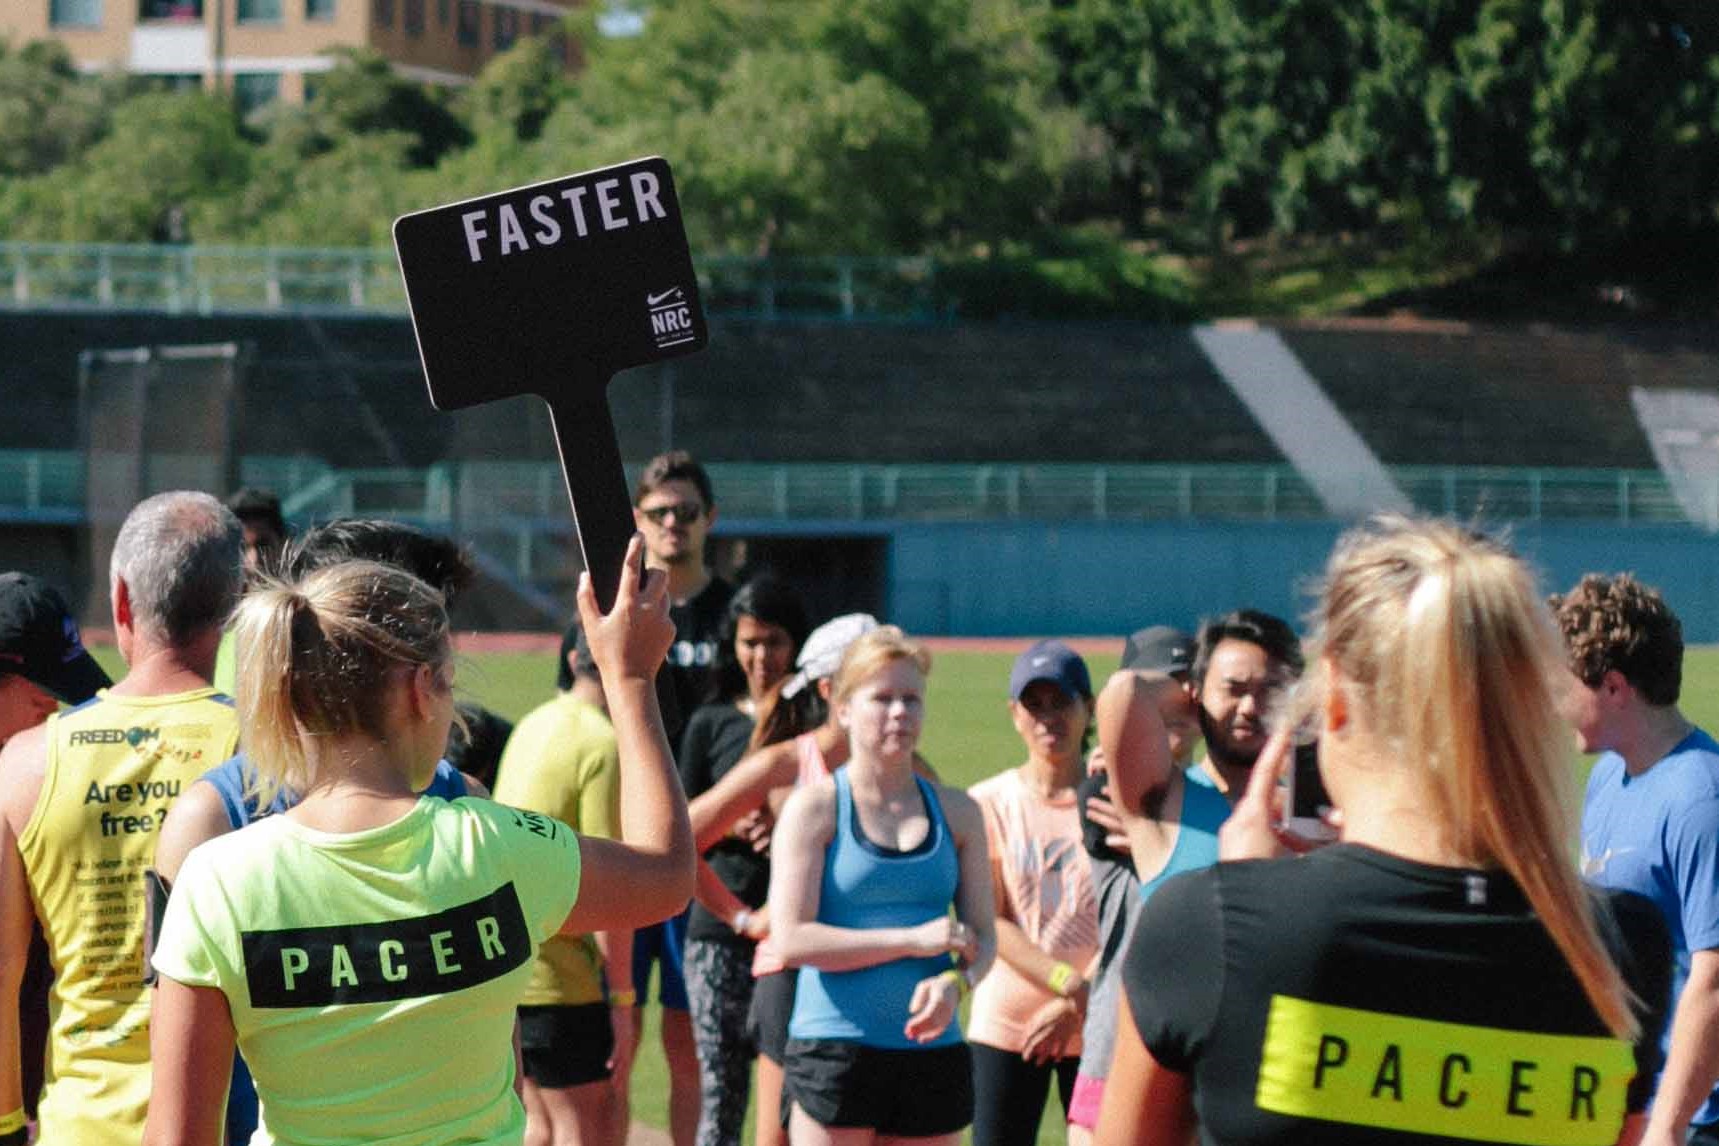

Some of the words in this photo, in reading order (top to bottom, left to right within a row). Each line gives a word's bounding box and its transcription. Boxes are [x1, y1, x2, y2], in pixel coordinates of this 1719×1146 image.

[462, 171, 667, 263] FASTER
[651, 307, 693, 335] NRC
[84, 780, 134, 805] Are
[137, 779, 181, 805] you
[280, 916, 507, 991] PACER
[1312, 1034, 1601, 1122] PACER
